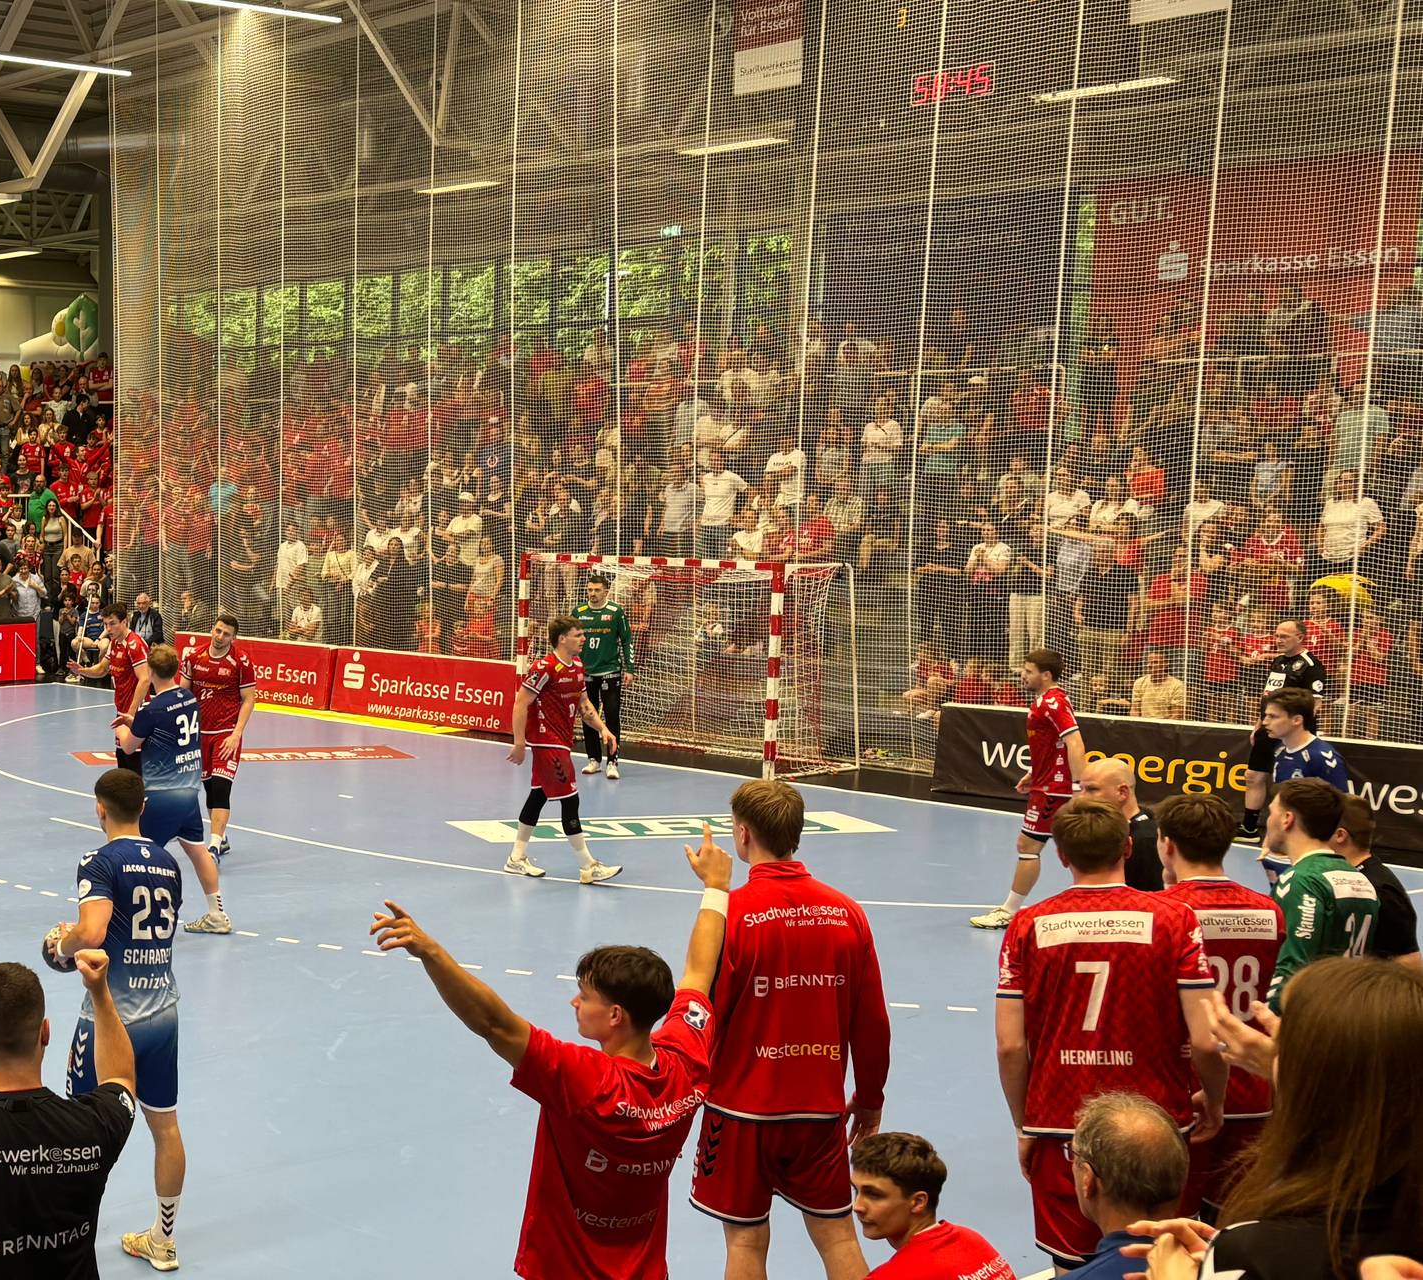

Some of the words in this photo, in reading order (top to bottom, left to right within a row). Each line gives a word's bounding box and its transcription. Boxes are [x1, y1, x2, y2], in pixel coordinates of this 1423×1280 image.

[589, 638, 601, 649] 87
[277, 663, 317, 686] Essen
[370, 673, 450, 699] Sparkasse
[454, 680, 504, 707] Essen
[367, 701, 501, 730] www.sparkasse-essen.de
[176, 711, 199, 747] 34
[131, 885, 174, 940] 23
[797, 918, 815, 927] sind
[1295, 894, 1317, 939] Stauder
[1041, 917, 1144, 933] Stadtwerkessen
[1093, 928, 1108, 936] sind
[1075, 961, 1110, 1031] 7
[1060, 1050, 1134, 1066] HERMELING
[9, 1165, 28, 1176] Wir
[30, 1163, 53, 1175] sind
